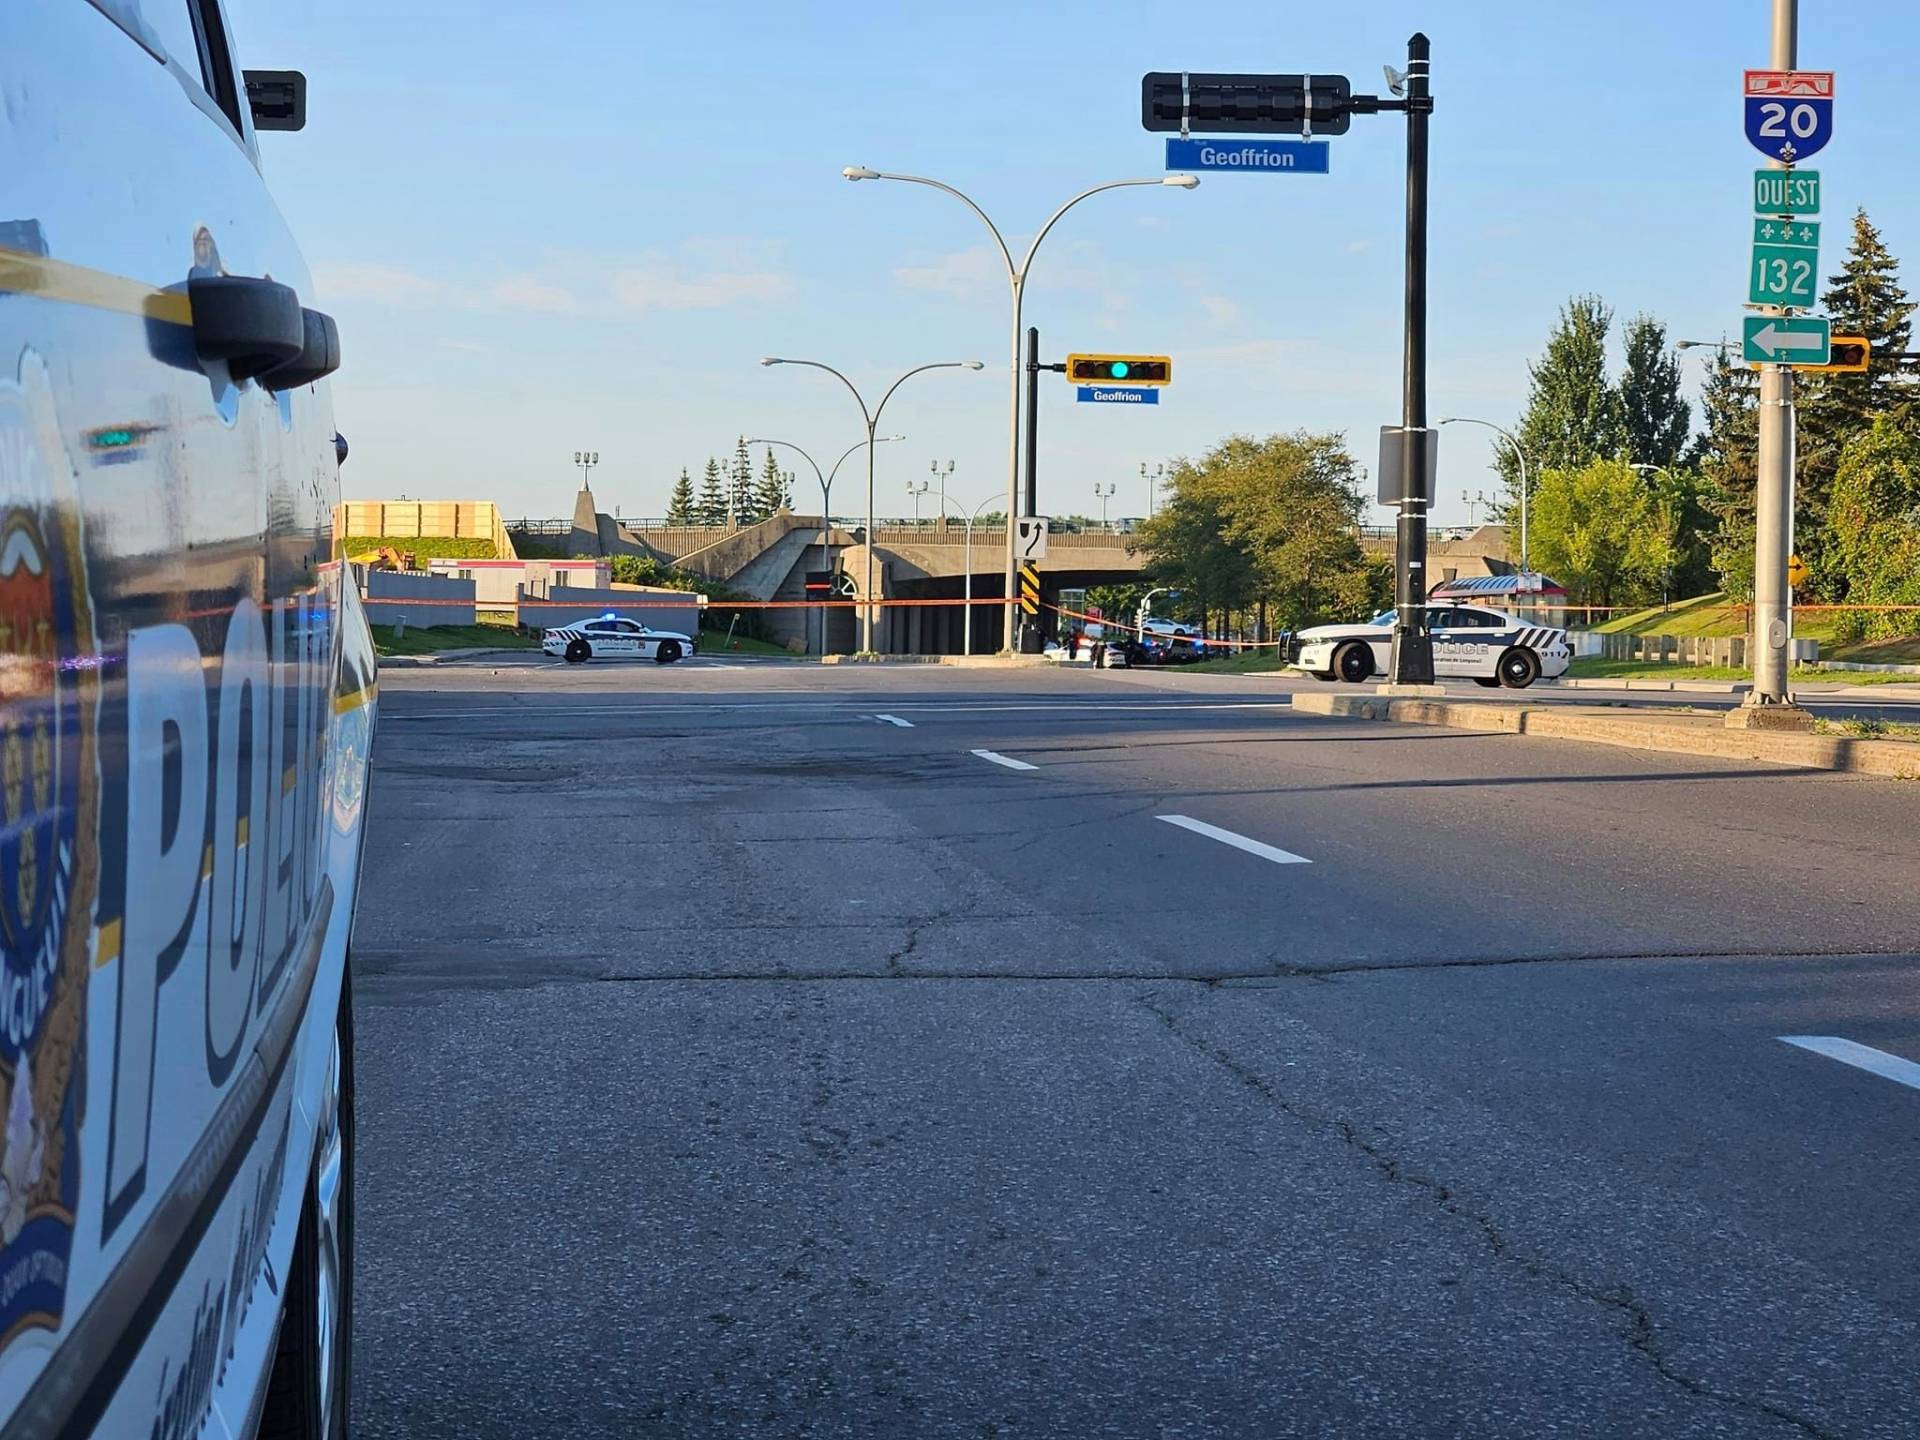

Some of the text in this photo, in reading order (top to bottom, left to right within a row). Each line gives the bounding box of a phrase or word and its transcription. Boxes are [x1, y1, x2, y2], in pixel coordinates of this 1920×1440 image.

[1759, 102, 1818, 138] 20
[1200, 147, 1295, 167] Geoffrion
[1757, 179, 1817, 206] OUEST
[1758, 258, 1811, 295] 132
[1093, 391, 1142, 402] Geoffrion
[1431, 641, 1489, 655] OLICE
